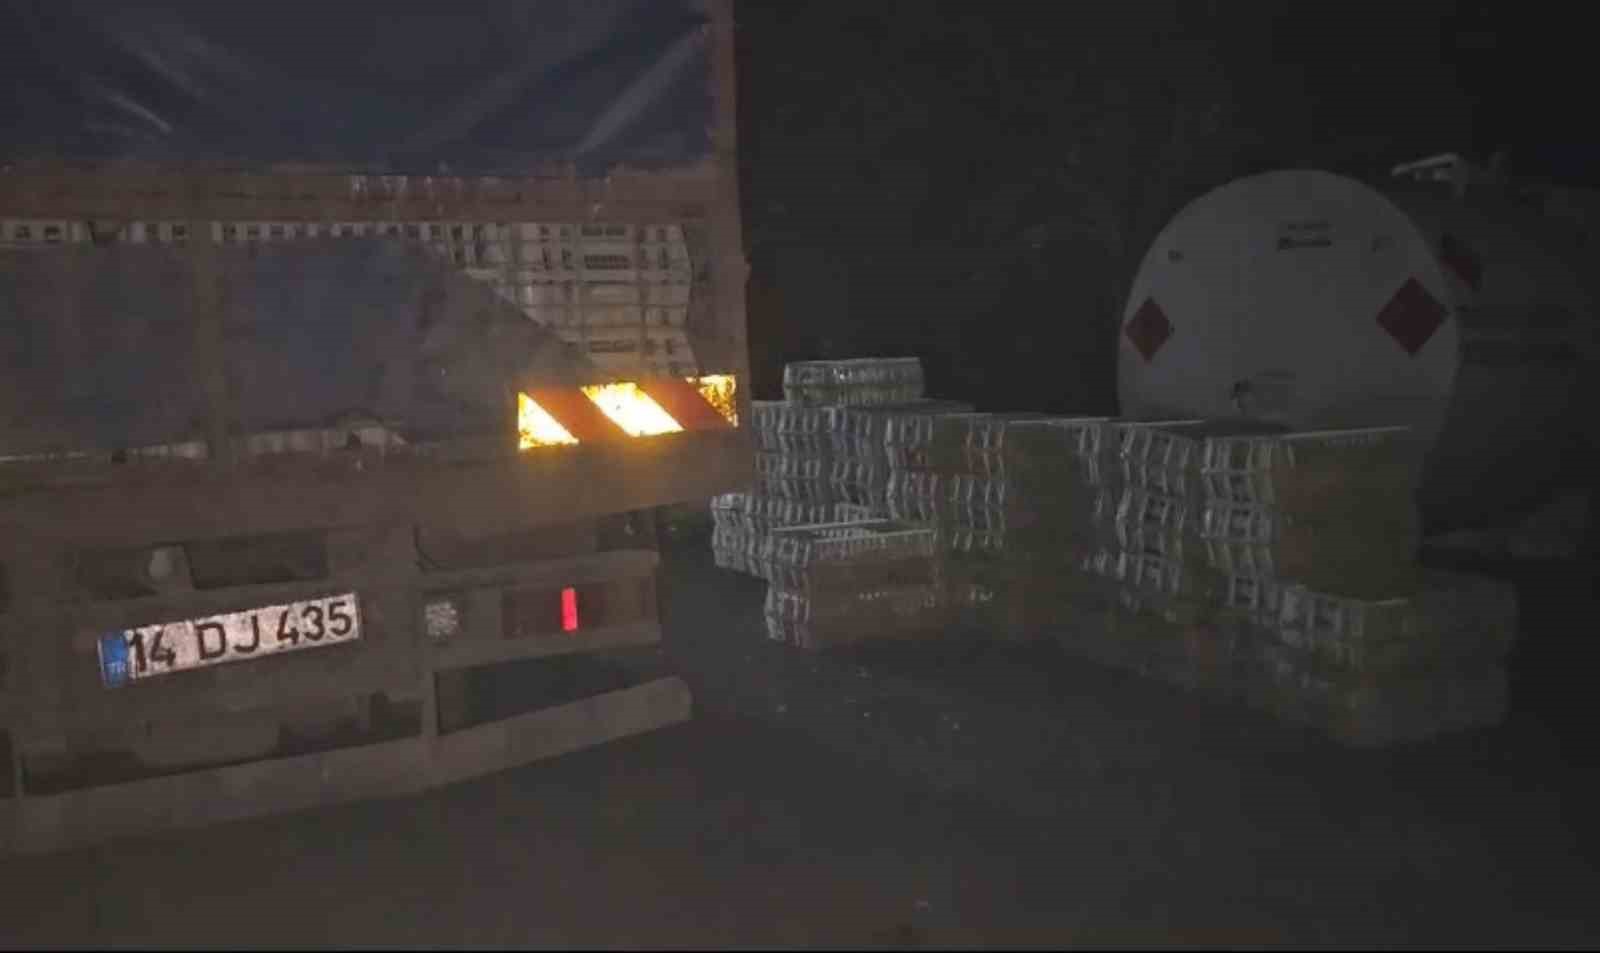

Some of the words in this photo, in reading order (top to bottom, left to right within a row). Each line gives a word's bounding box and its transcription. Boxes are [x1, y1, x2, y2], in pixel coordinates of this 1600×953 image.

[129, 630, 176, 672] 14
[194, 615, 261, 660] DJ
[276, 601, 352, 646] 435
